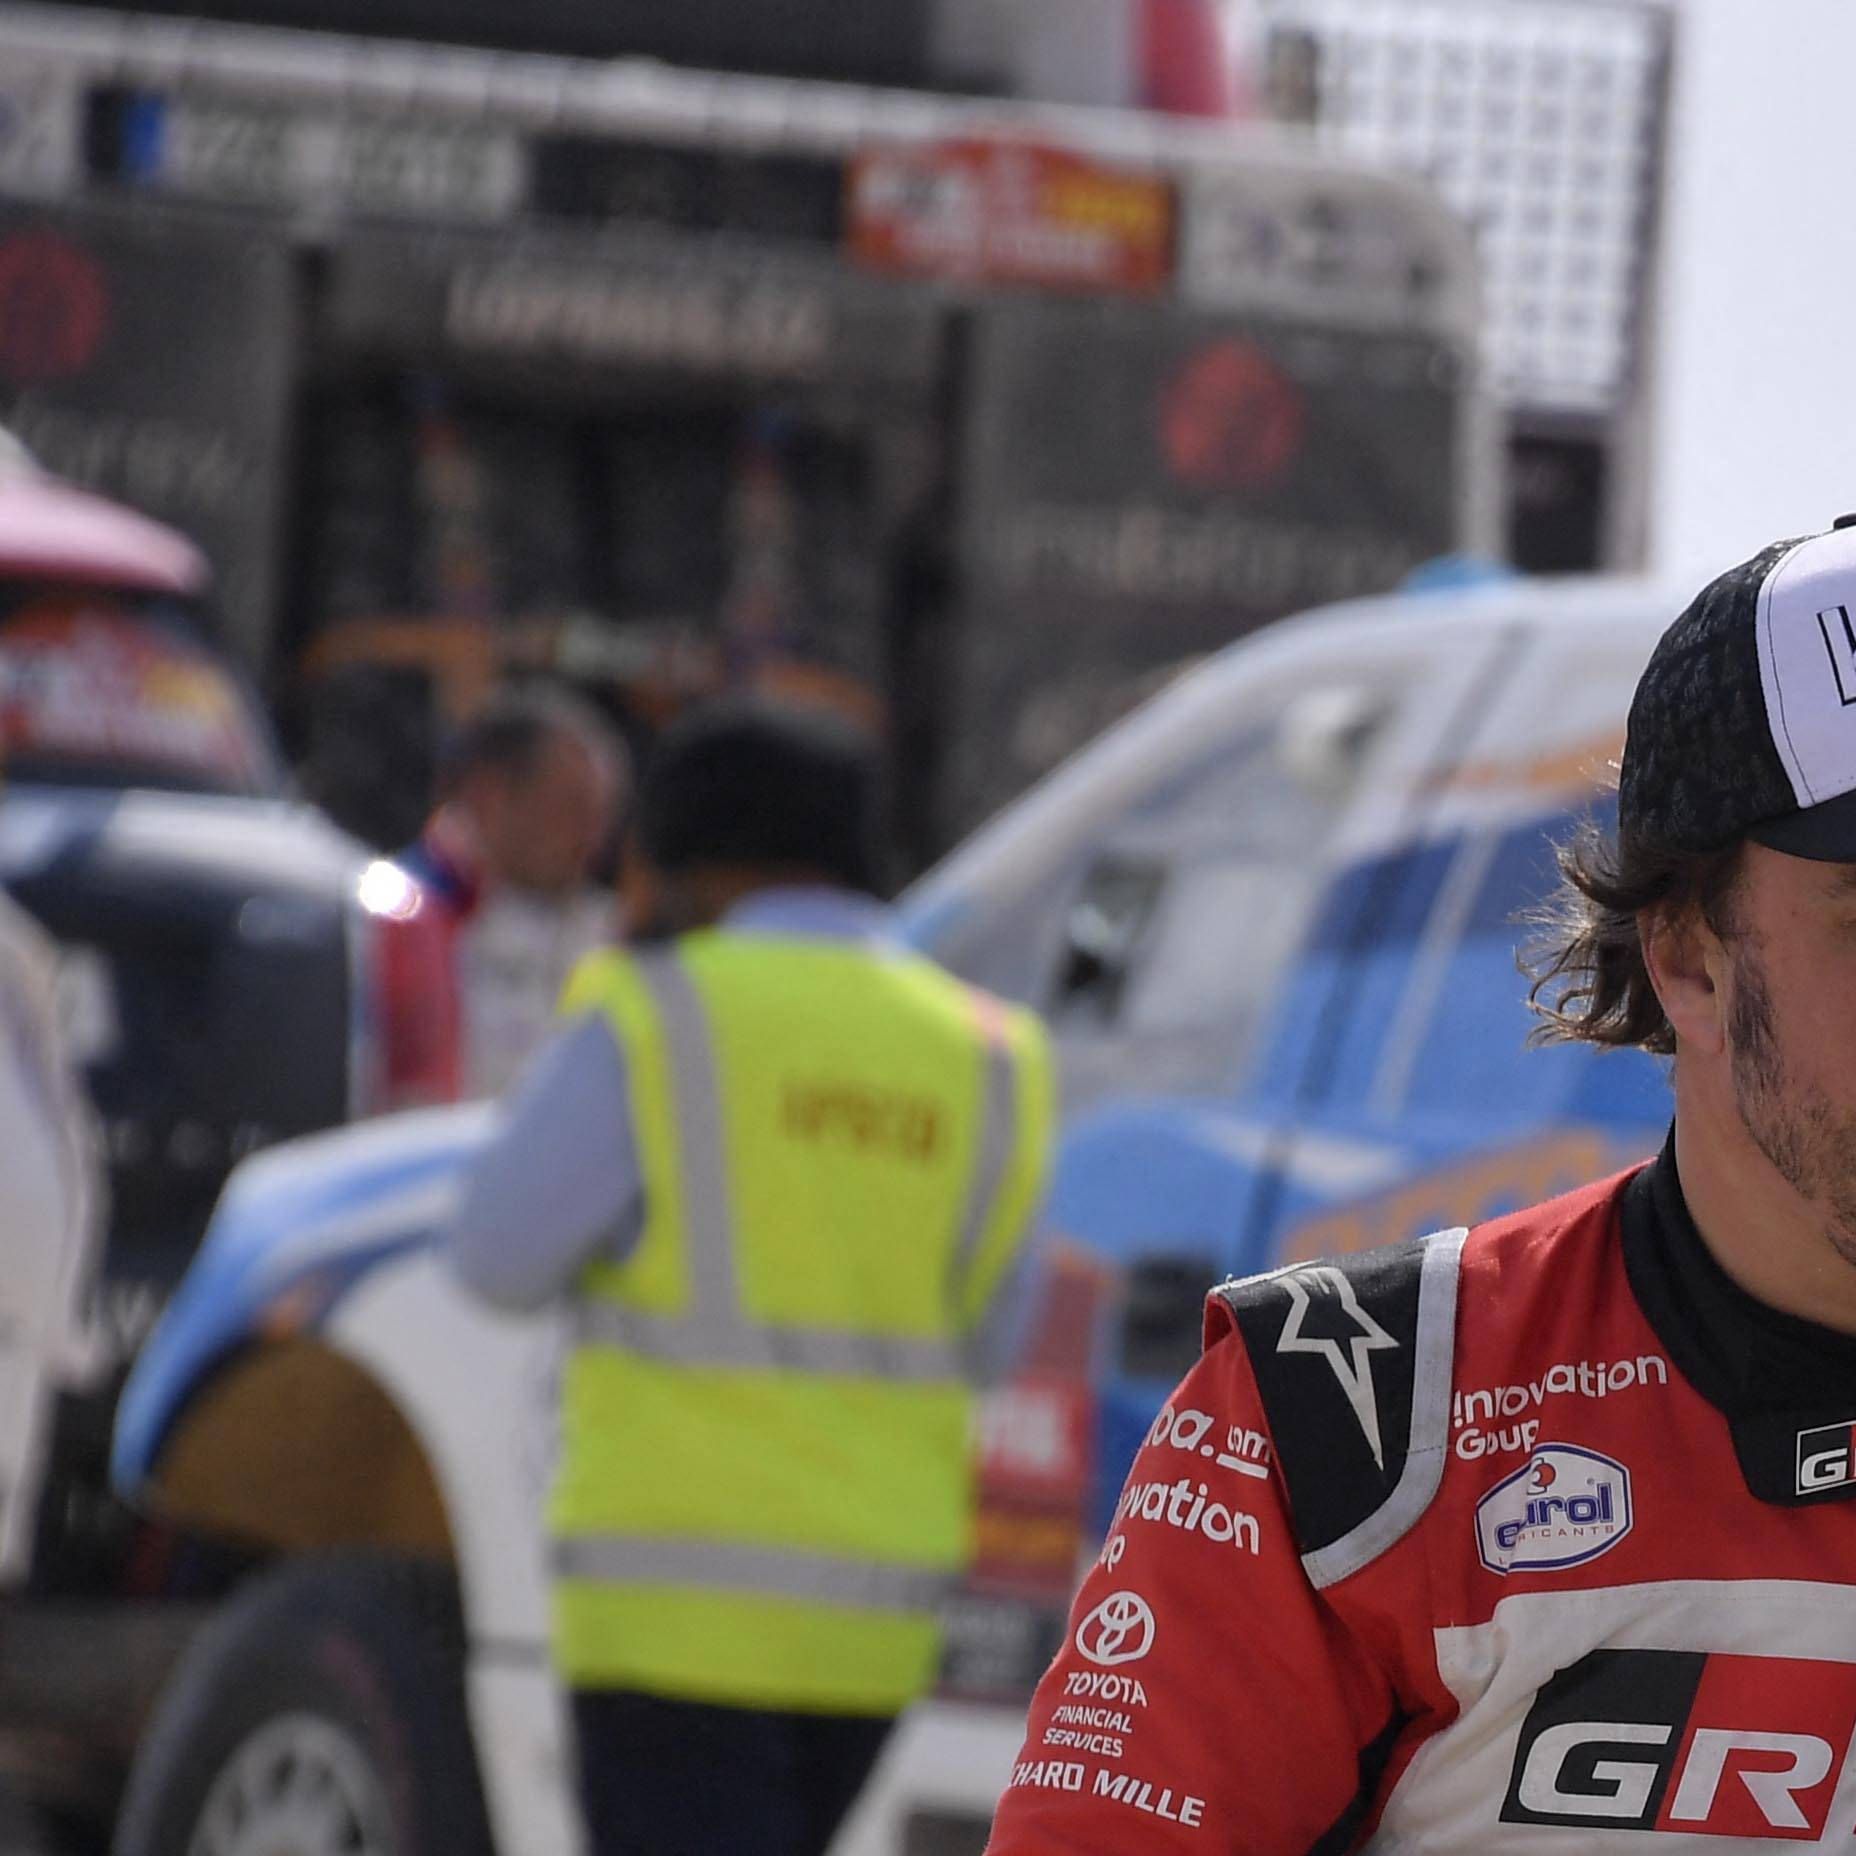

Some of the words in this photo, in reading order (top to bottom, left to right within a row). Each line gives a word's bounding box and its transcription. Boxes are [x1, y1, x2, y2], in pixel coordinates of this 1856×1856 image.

[1062, 1670, 1149, 1708] TOYOTA
[1050, 1704, 1134, 1734] FINANCIAL
[1041, 1727, 1124, 1758] SERVICES
[1517, 1721, 1834, 1831] GR
[1092, 1769, 1206, 1828] MILLE
